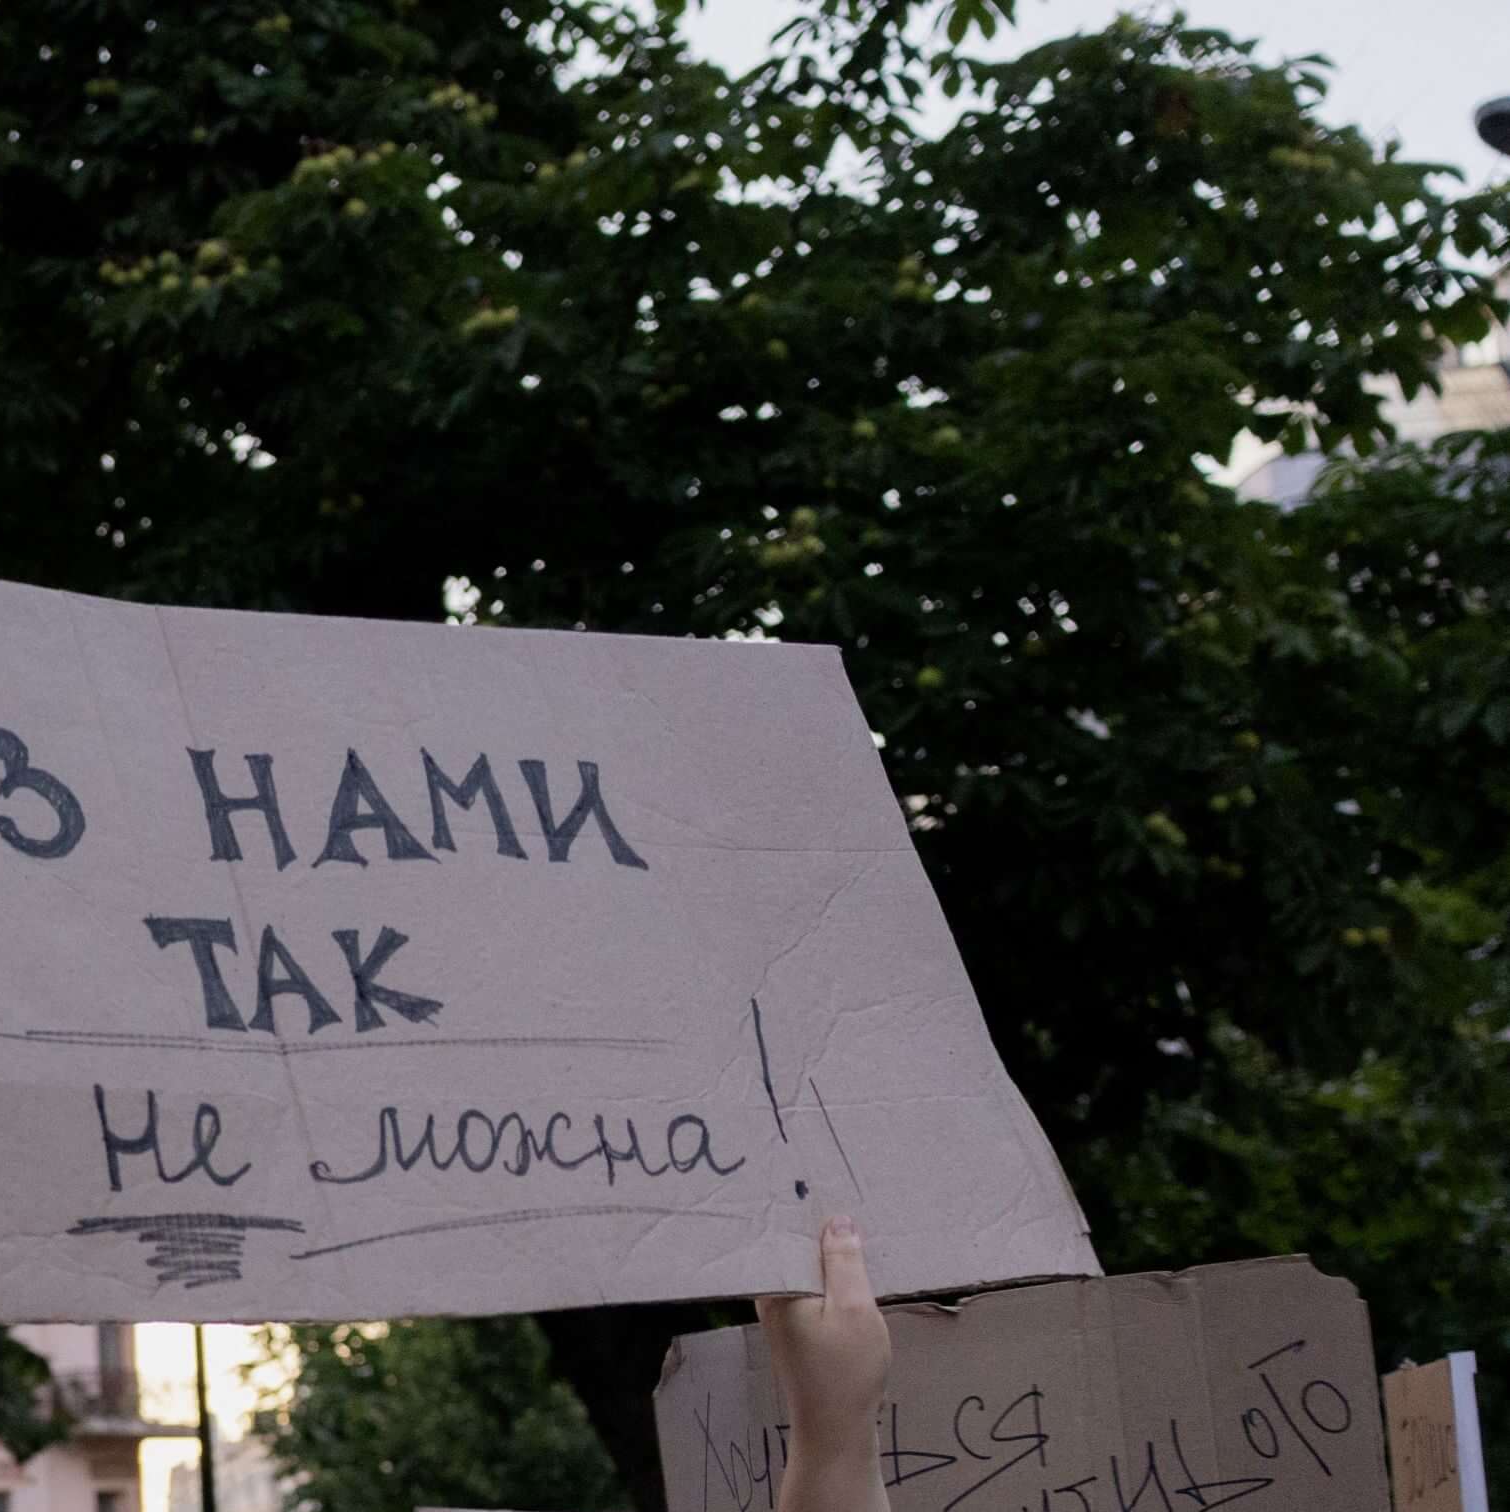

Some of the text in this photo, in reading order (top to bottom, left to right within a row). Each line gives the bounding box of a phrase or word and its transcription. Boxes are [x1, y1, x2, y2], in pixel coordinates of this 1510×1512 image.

[186, 747, 649, 872] НАМИ
[143, 916, 444, 1035] ТАК
[93, 1083, 252, 1193] Не
